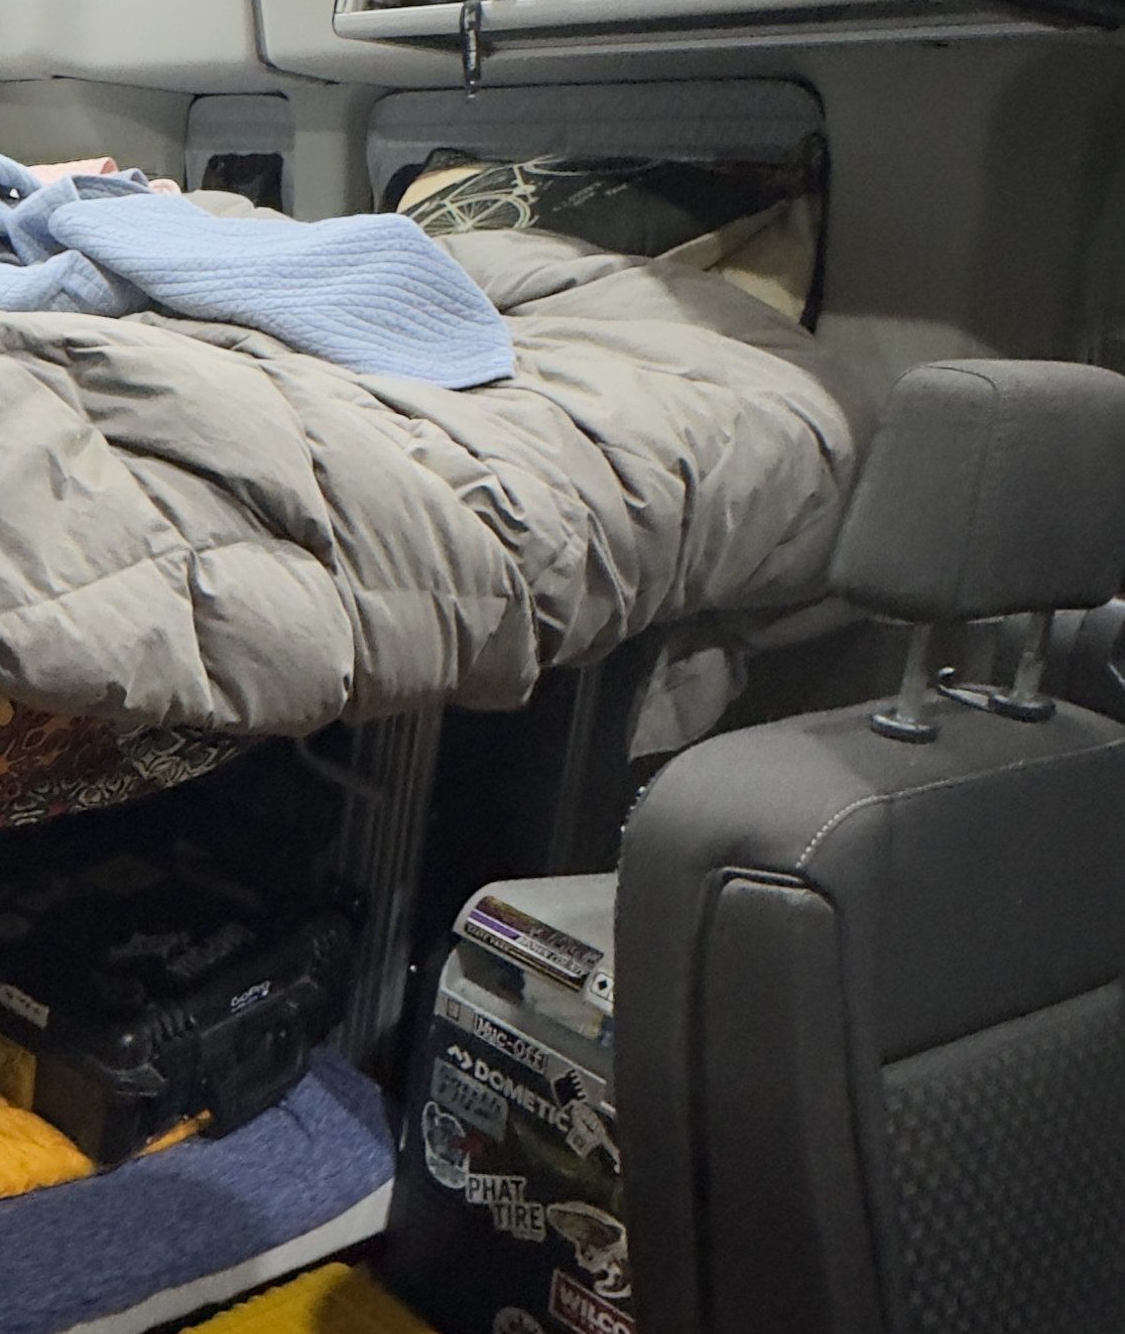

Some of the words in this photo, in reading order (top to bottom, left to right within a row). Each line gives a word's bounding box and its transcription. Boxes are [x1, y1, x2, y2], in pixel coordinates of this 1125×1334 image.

[475, 1058, 570, 1132] DOMETIC
[469, 1177, 523, 1201] PHAT
[495, 1204, 542, 1230] TIRE
